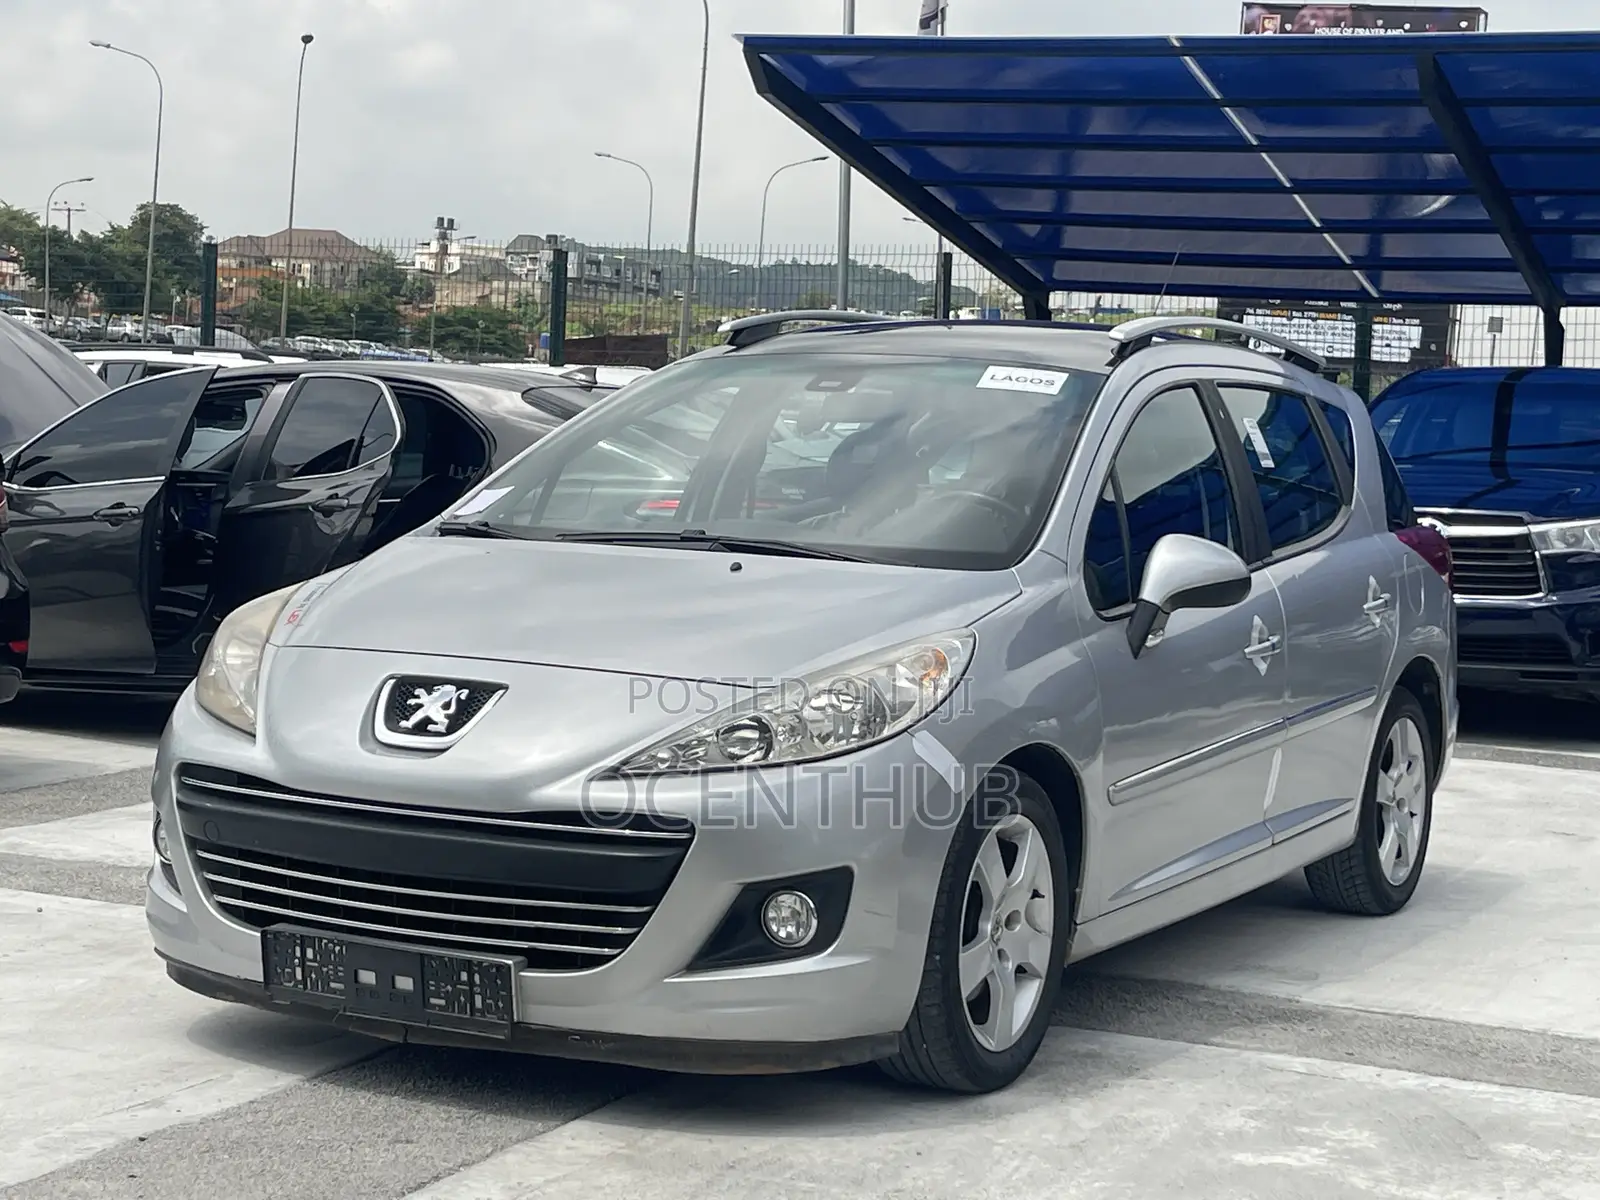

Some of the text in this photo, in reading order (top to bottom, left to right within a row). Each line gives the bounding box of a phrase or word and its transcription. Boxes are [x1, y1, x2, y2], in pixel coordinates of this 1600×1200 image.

[1315, 27, 1341, 35] HOUSE
[1343, 27, 1354, 35] OF
[990, 374, 1055, 386] LAGOS
